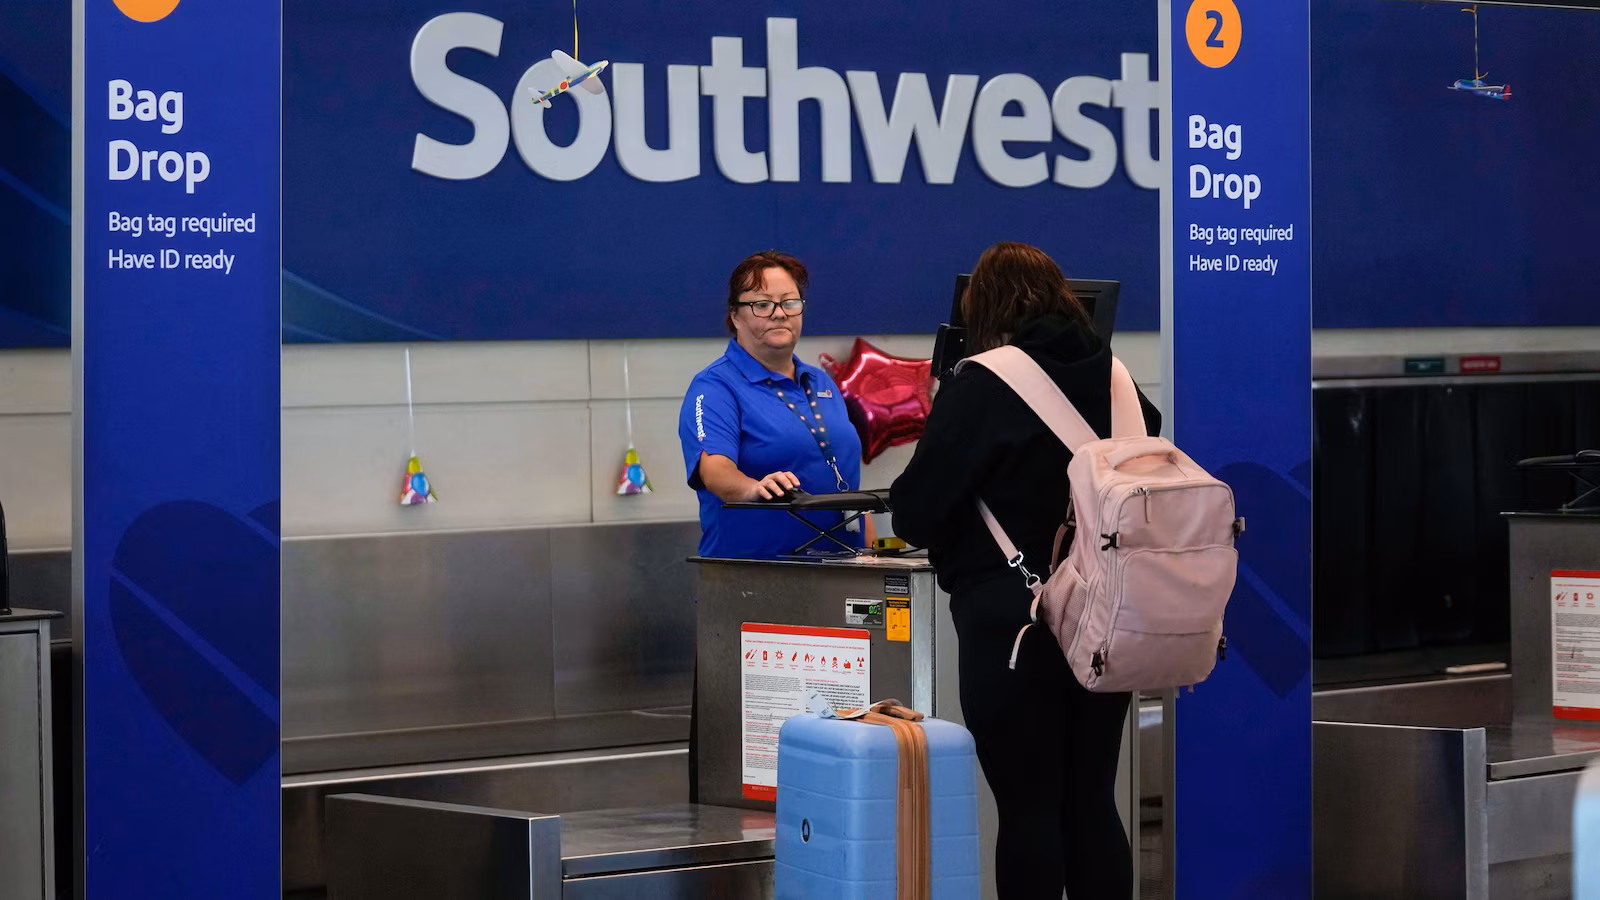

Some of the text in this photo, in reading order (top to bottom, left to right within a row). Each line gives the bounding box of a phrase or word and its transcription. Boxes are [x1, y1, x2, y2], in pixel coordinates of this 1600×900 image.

[1205, 9, 1225, 49] 2
[108, 79, 184, 134] Bag
[410, 12, 1160, 189] Southwest
[1188, 115, 1242, 160] Bag
[108, 140, 211, 194] Drop
[1189, 164, 1262, 209] Drop
[108, 212, 256, 238] Bag tag required
[1189, 223, 1294, 246] Bag tag required
[108, 248, 235, 275] Have ID ready
[1189, 254, 1279, 276] Have ID ready
[695, 394, 706, 438] Southwest
